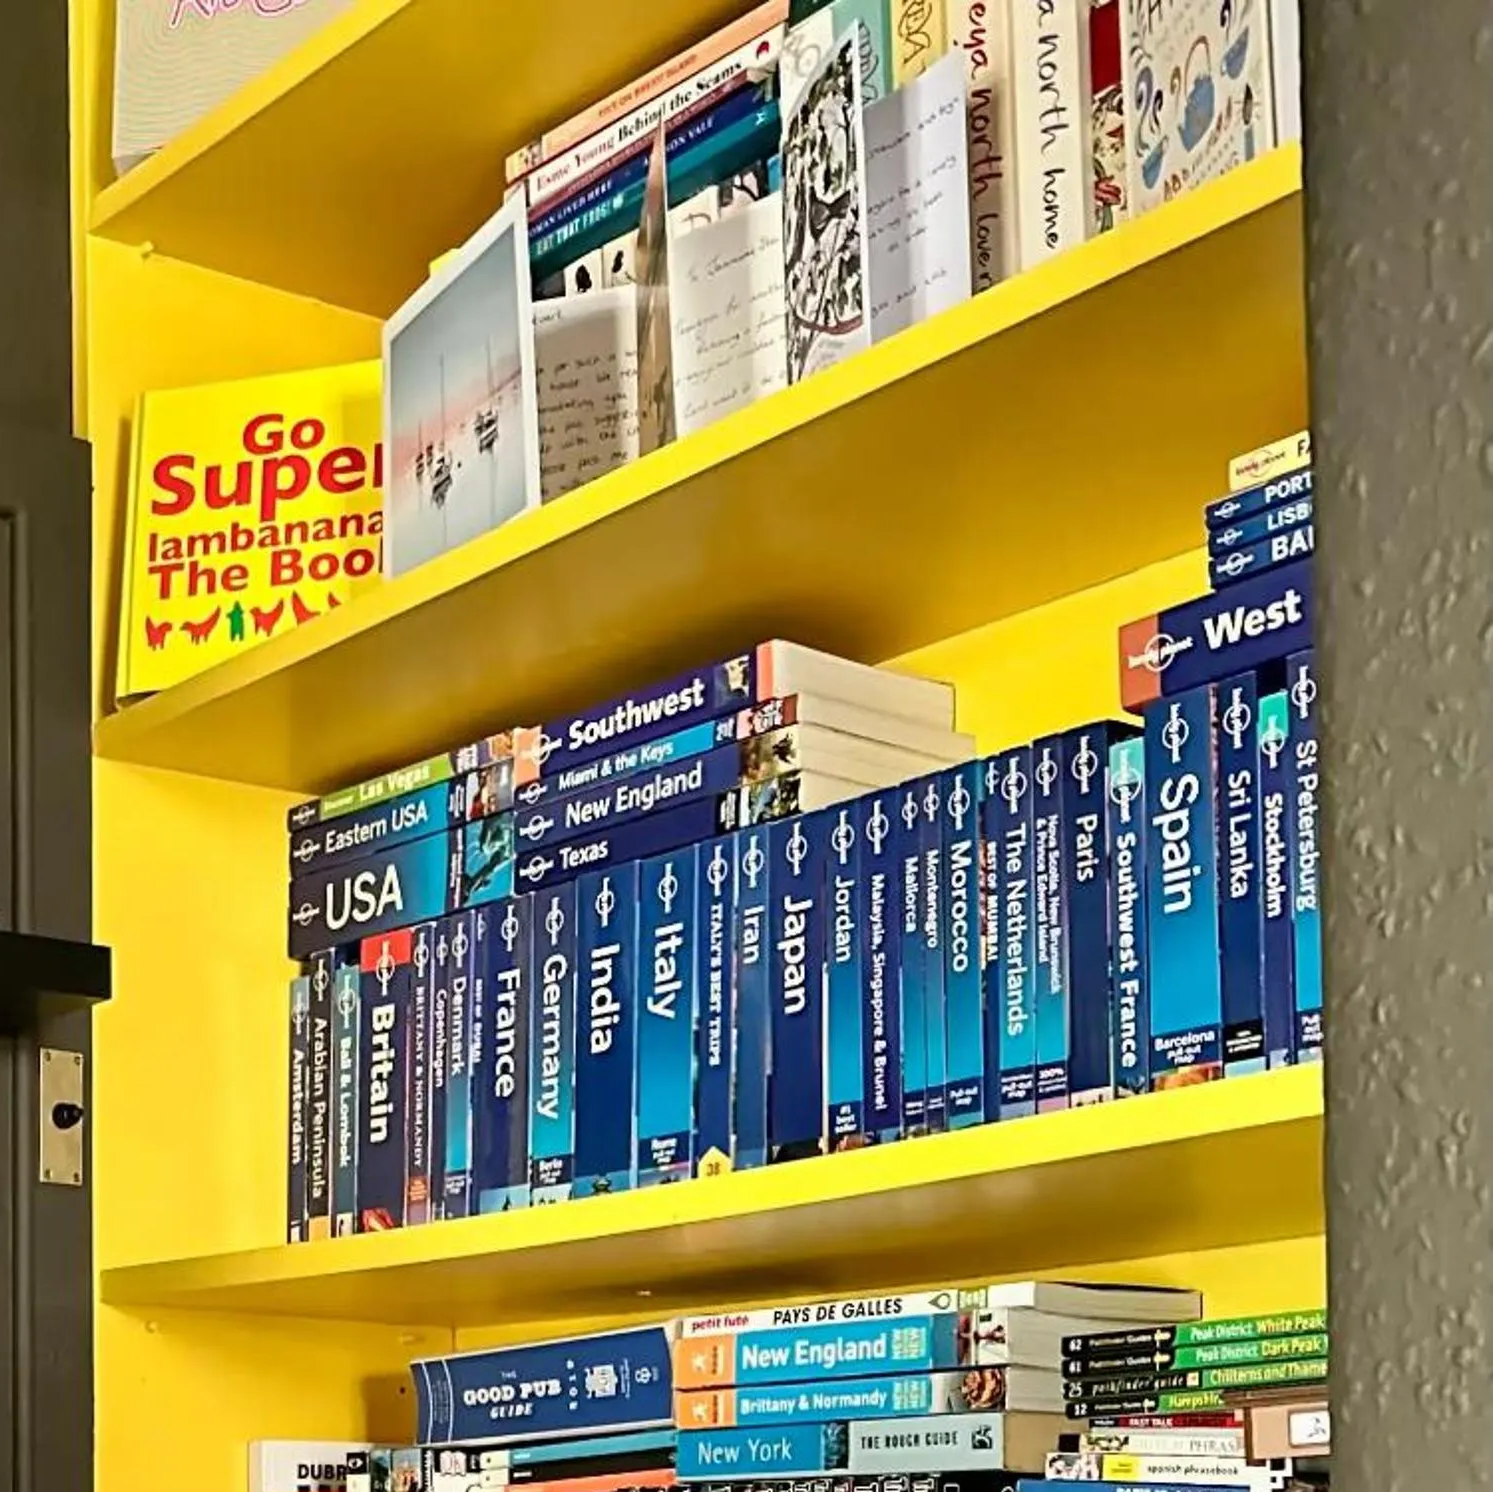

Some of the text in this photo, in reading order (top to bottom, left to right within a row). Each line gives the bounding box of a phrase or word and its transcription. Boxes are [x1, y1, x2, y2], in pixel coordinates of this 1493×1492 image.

[618, 102, 666, 141] Behind
[669, 90, 693, 112] the
[696, 61, 742, 92] Seams
[969, 89, 1002, 200] north
[1039, 34, 1069, 250] north home
[558, 218, 580, 244] THAT
[243, 414, 325, 454] Go
[148, 510, 384, 562] lambanana
[1267, 502, 1312, 531] LISB
[148, 536, 383, 600] The Boo
[1202, 588, 1303, 650] West
[568, 678, 704, 751] Southwest
[325, 804, 428, 853] Eastern USA
[565, 764, 702, 829] New England
[1227, 769, 1255, 899] Sri Lanka
[1294, 739, 1318, 912] St Petersburg
[559, 840, 608, 870] Texas
[1075, 813, 1099, 882] Paris
[1153, 772, 1202, 915] Spain
[1263, 792, 1287, 919] Stockholm
[325, 864, 403, 931] USA
[742, 905, 764, 965] Iran
[834, 875, 855, 963] Jordan
[904, 857, 919, 933] Mallorca
[925, 849, 939, 949] Montenegro
[949, 840, 971, 972] Morocco
[1006, 823, 1028, 1036] The Netherlands
[647, 921, 684, 1019] Italy
[777, 895, 813, 1015] Japan
[1116, 831, 1138, 1068] Southwest France
[451, 976, 467, 1076] Denmark
[495, 968, 521, 1099] France
[590, 943, 620, 1055] India
[870, 952, 885, 1036] Singapore
[369, 1003, 396, 1143] Britain
[434, 989, 447, 1088] Copenhagen
[536, 954, 567, 1120] Germany
[291, 1049, 304, 1165] Amsterdam
[311, 1017, 327, 1199] Arabian Peninsula
[339, 1092, 352, 1168] Lombok
[742, 1333, 887, 1370] New England
[773, 1298, 903, 1326] PAYS DE GALLES
[1262, 1342, 1289, 1356] Dark
[463, 1379, 563, 1407] GOOD PUB
[740, 1389, 888, 1417] Brittany Normandy
[1068, 1383, 1083, 1398] 25
[697, 1437, 793, 1466] New York
